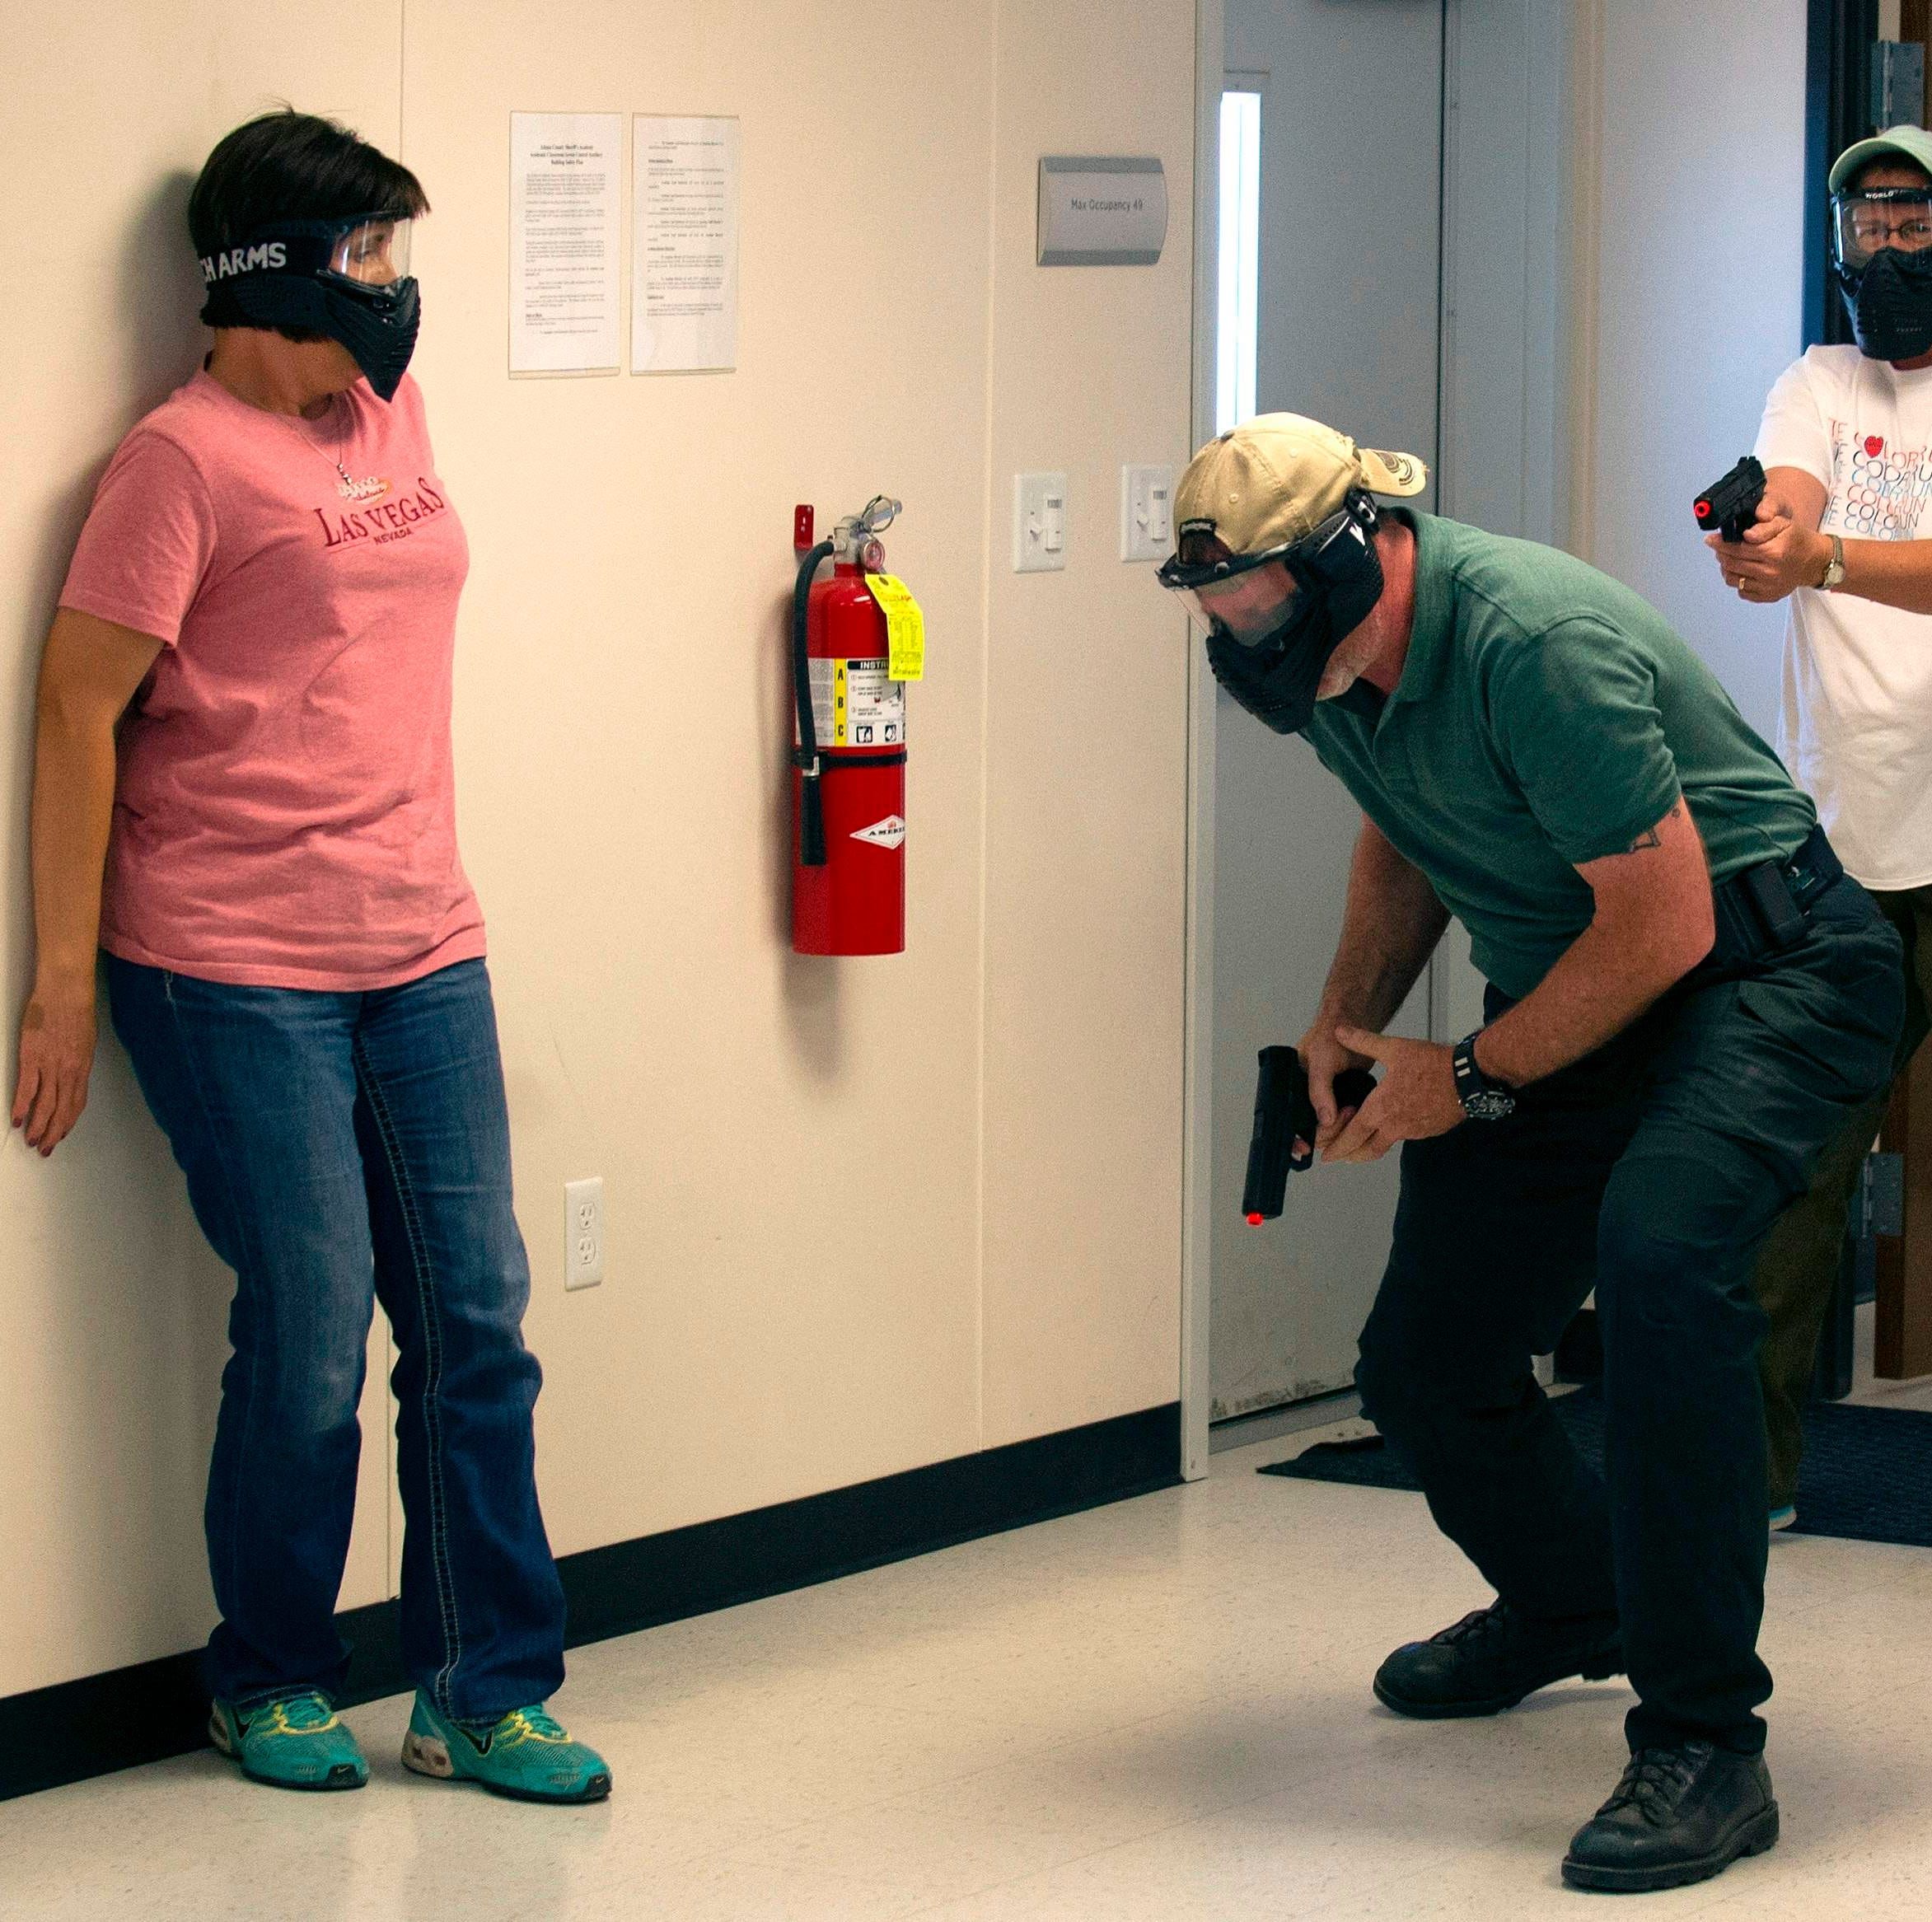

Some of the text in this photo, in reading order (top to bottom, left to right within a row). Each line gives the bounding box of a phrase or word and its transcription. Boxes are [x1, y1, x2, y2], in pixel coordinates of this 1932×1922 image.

[1071, 199, 1143, 212] Max Occupancy 49
[314, 507, 368, 547] LAS
[365, 477, 444, 530] VEGAS
[373, 527, 413, 545] NEVADA
[860, 661, 889, 671] INSTR
[837, 669, 844, 680] A
[838, 696, 844, 708] B
[838, 724, 844, 737] C
